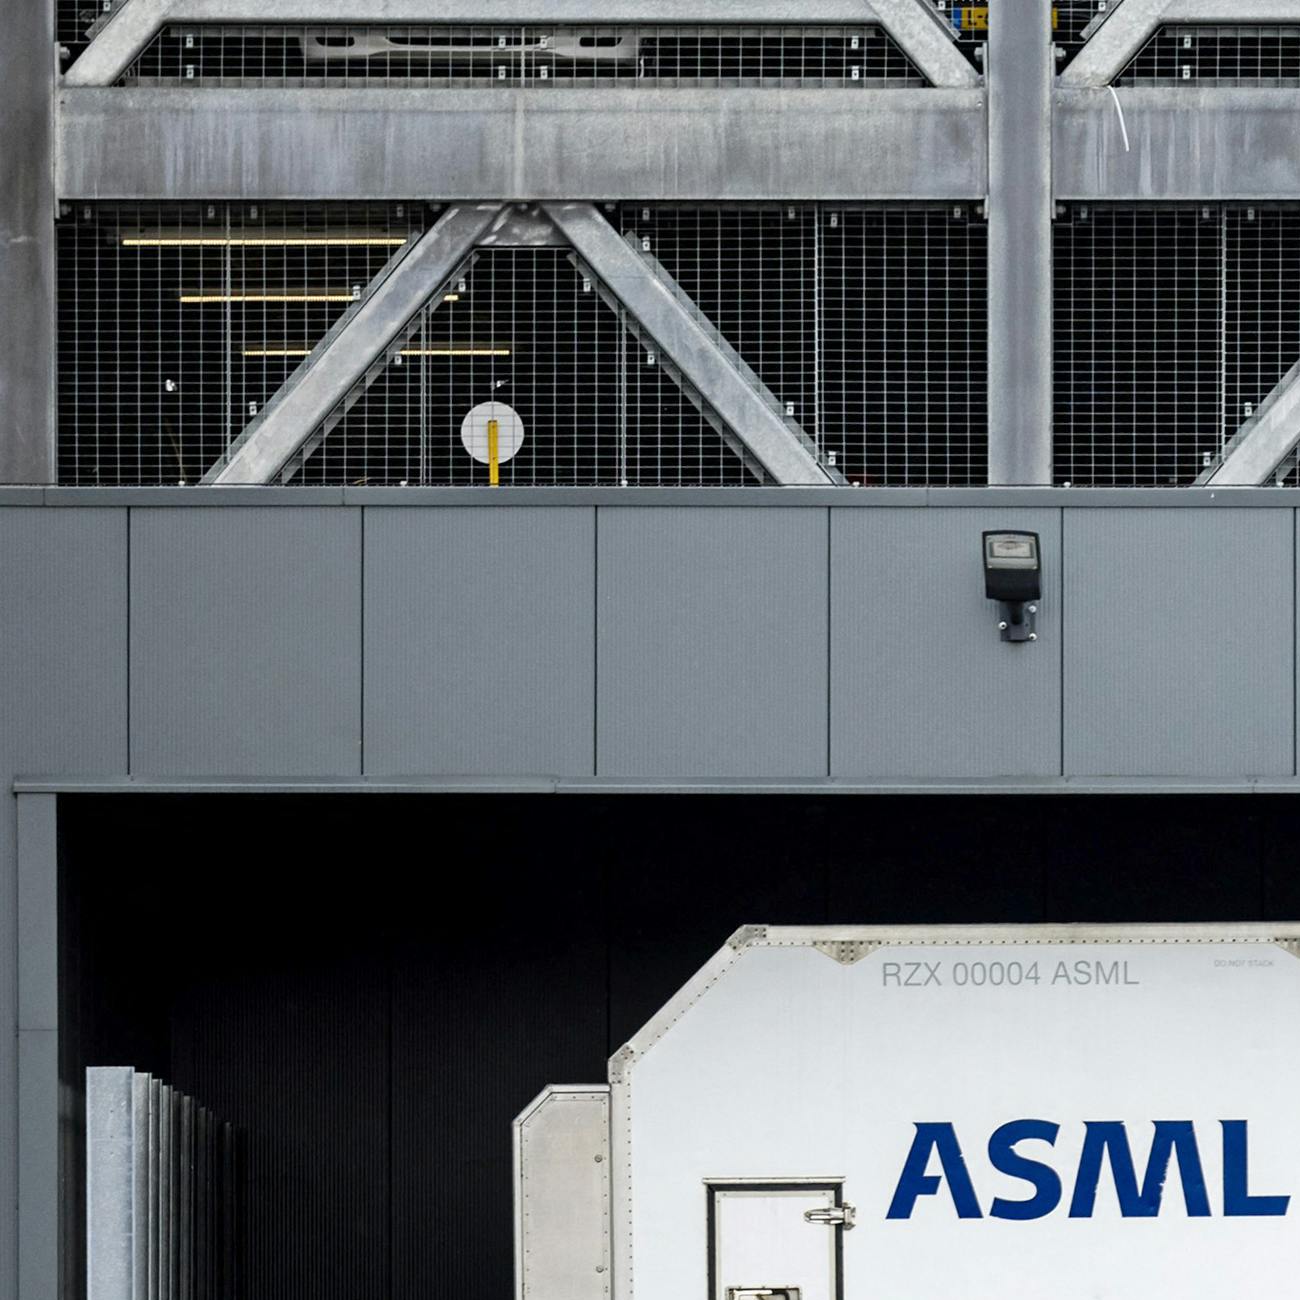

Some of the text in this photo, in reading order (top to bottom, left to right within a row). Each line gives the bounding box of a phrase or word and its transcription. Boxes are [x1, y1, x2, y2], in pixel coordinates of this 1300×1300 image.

[882, 960, 1140, 987] RZX 00004 ASML
[886, 1119, 1291, 1220] ASML
